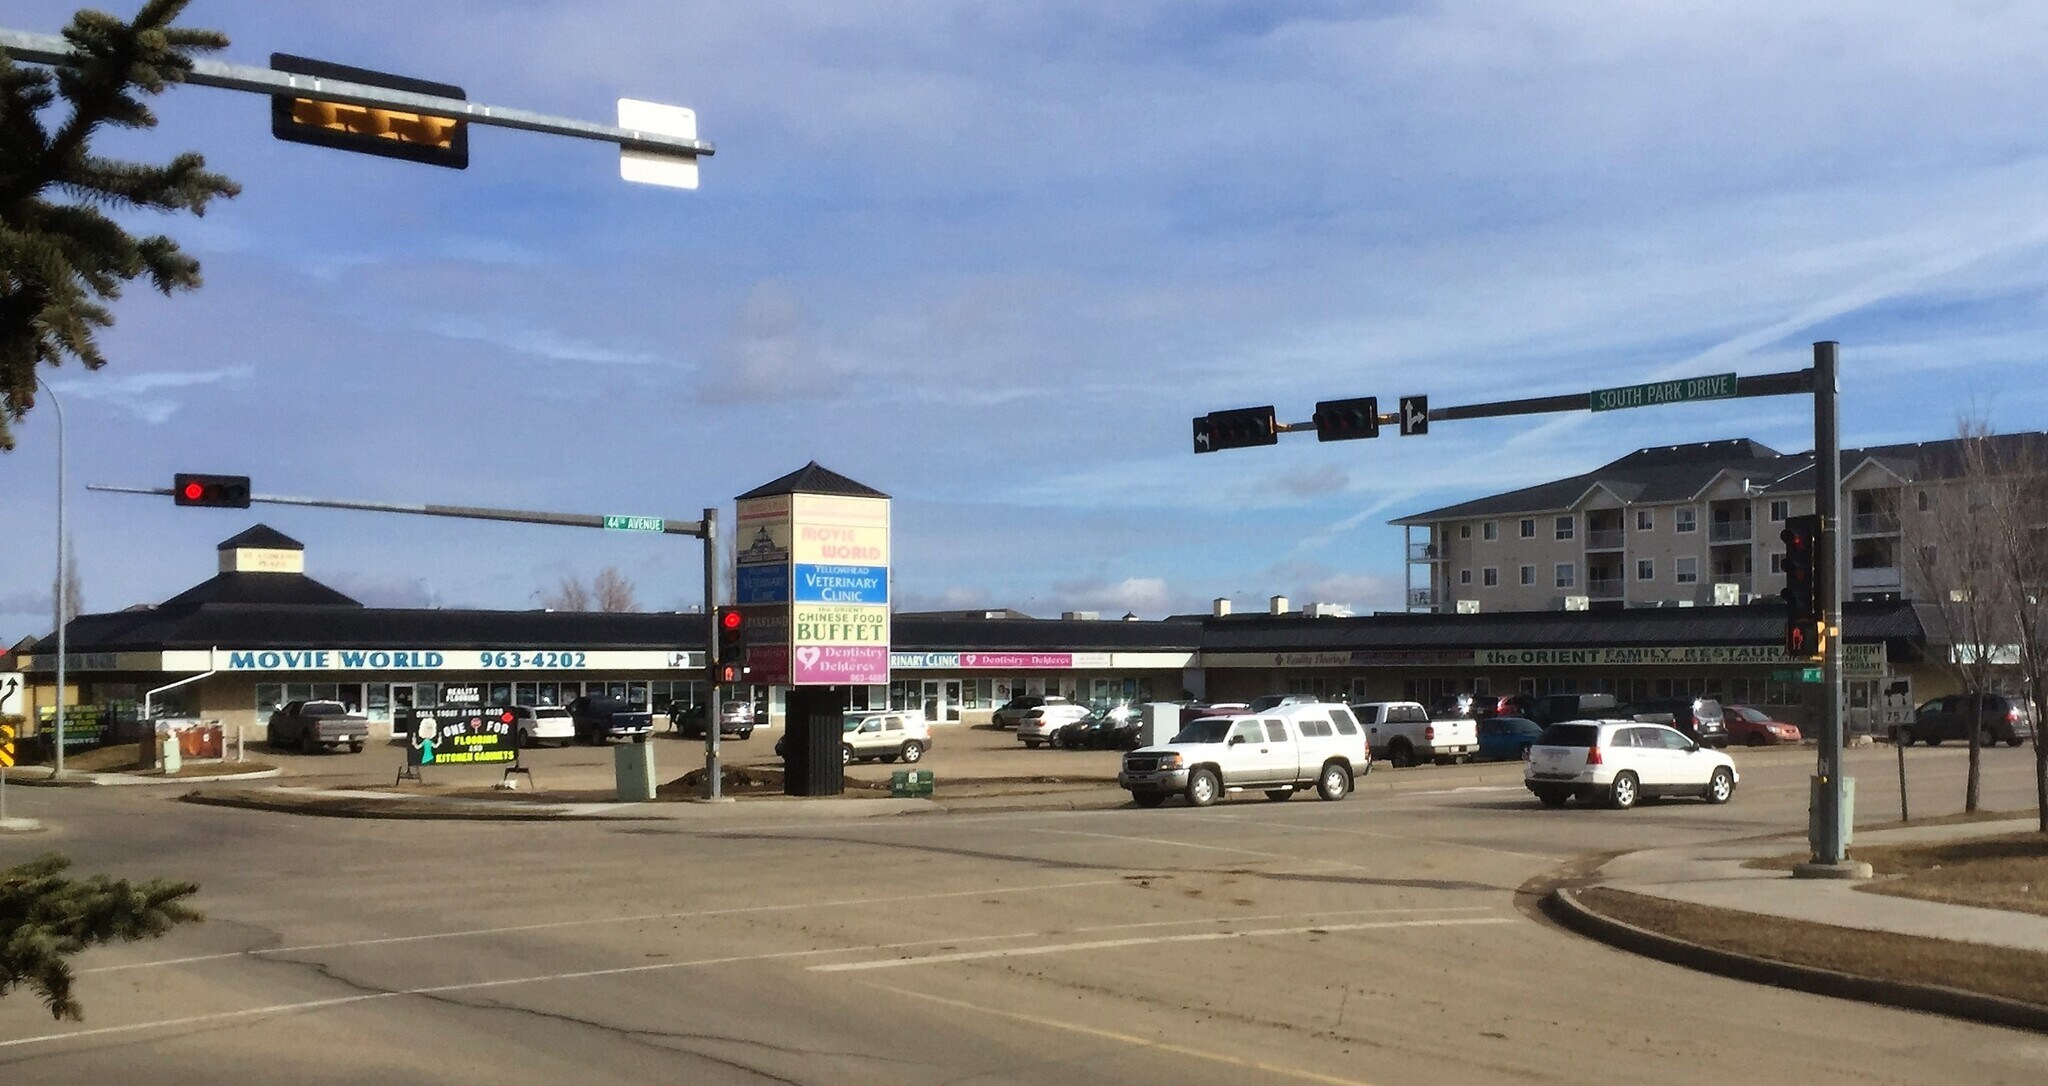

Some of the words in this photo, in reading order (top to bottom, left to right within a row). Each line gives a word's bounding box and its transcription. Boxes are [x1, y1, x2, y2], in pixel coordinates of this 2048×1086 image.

[1600, 387, 1642, 409] SOUTH
[1647, 382, 1683, 402] PARK
[1687, 376, 1728, 398] DRIVE
[628, 517, 661, 531] AVENUE
[801, 527, 856, 541] MOVIE
[822, 545, 881, 560] WORLD
[815, 565, 870, 574] YELLOWHEAD
[806, 573, 879, 588] VETERINARY
[821, 588, 863, 602] CLINIC
[798, 613, 849, 622] CHINESE
[853, 614, 884, 623] FOOD
[797, 622, 884, 641] BUFFET
[825, 647, 885, 659] Dentistry
[1486, 651, 1518, 664] the
[1520, 650, 1600, 663] ORIENT
[1604, 648, 1671, 658] FAMILY
[1846, 645, 1881, 655] ORIENT
[229, 651, 329, 669] MOVIE
[340, 651, 444, 669] WORLD
[480, 652, 587, 668] 963-4202
[926, 653, 958, 667] CLINIC
[982, 655, 1024, 664] Dentistry
[443, 722, 466, 737] ONE
[486, 721, 509, 734] FOR
[454, 735, 498, 745] FLOORING
[469, 745, 483, 753] AND
[436, 753, 473, 763] KITCHEN
[474, 751, 514, 762] CABINETS
